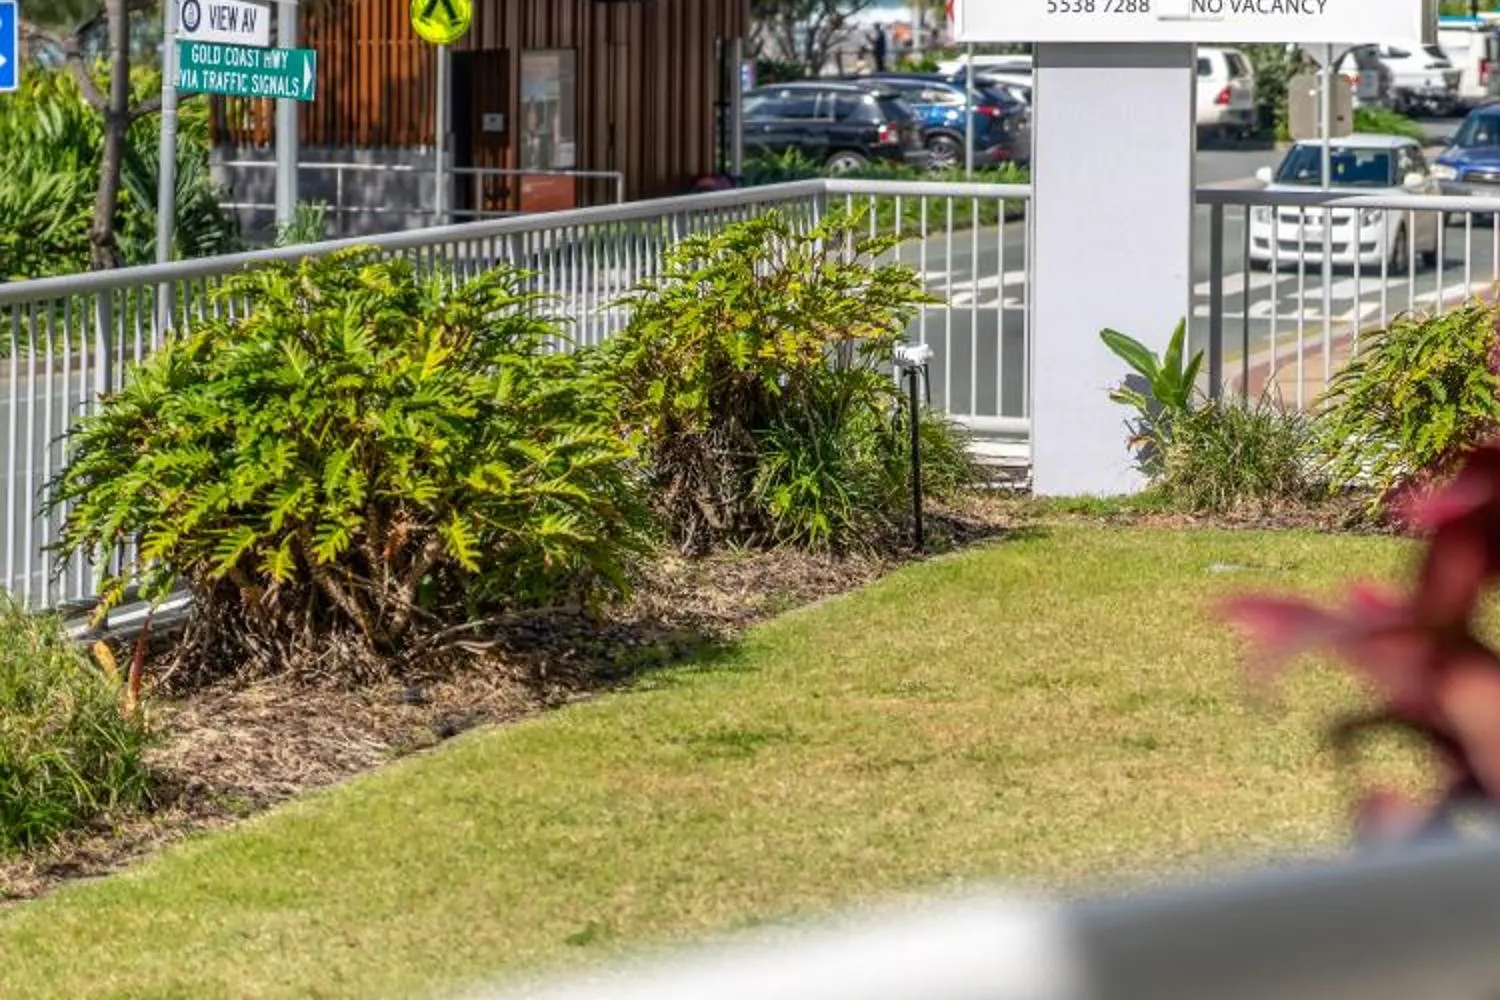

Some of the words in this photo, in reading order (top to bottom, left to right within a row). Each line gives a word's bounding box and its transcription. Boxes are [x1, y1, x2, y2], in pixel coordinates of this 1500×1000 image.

[209, 4, 239, 32] VIEW
[241, 7, 257, 34] AV
[191, 44, 221, 65] GOLD
[225, 46, 260, 69] COAST
[263, 50, 289, 70] HWY
[180, 68, 199, 88] VIA
[202, 70, 250, 92] TRAFFIC
[251, 74, 300, 97] SIGNALS
